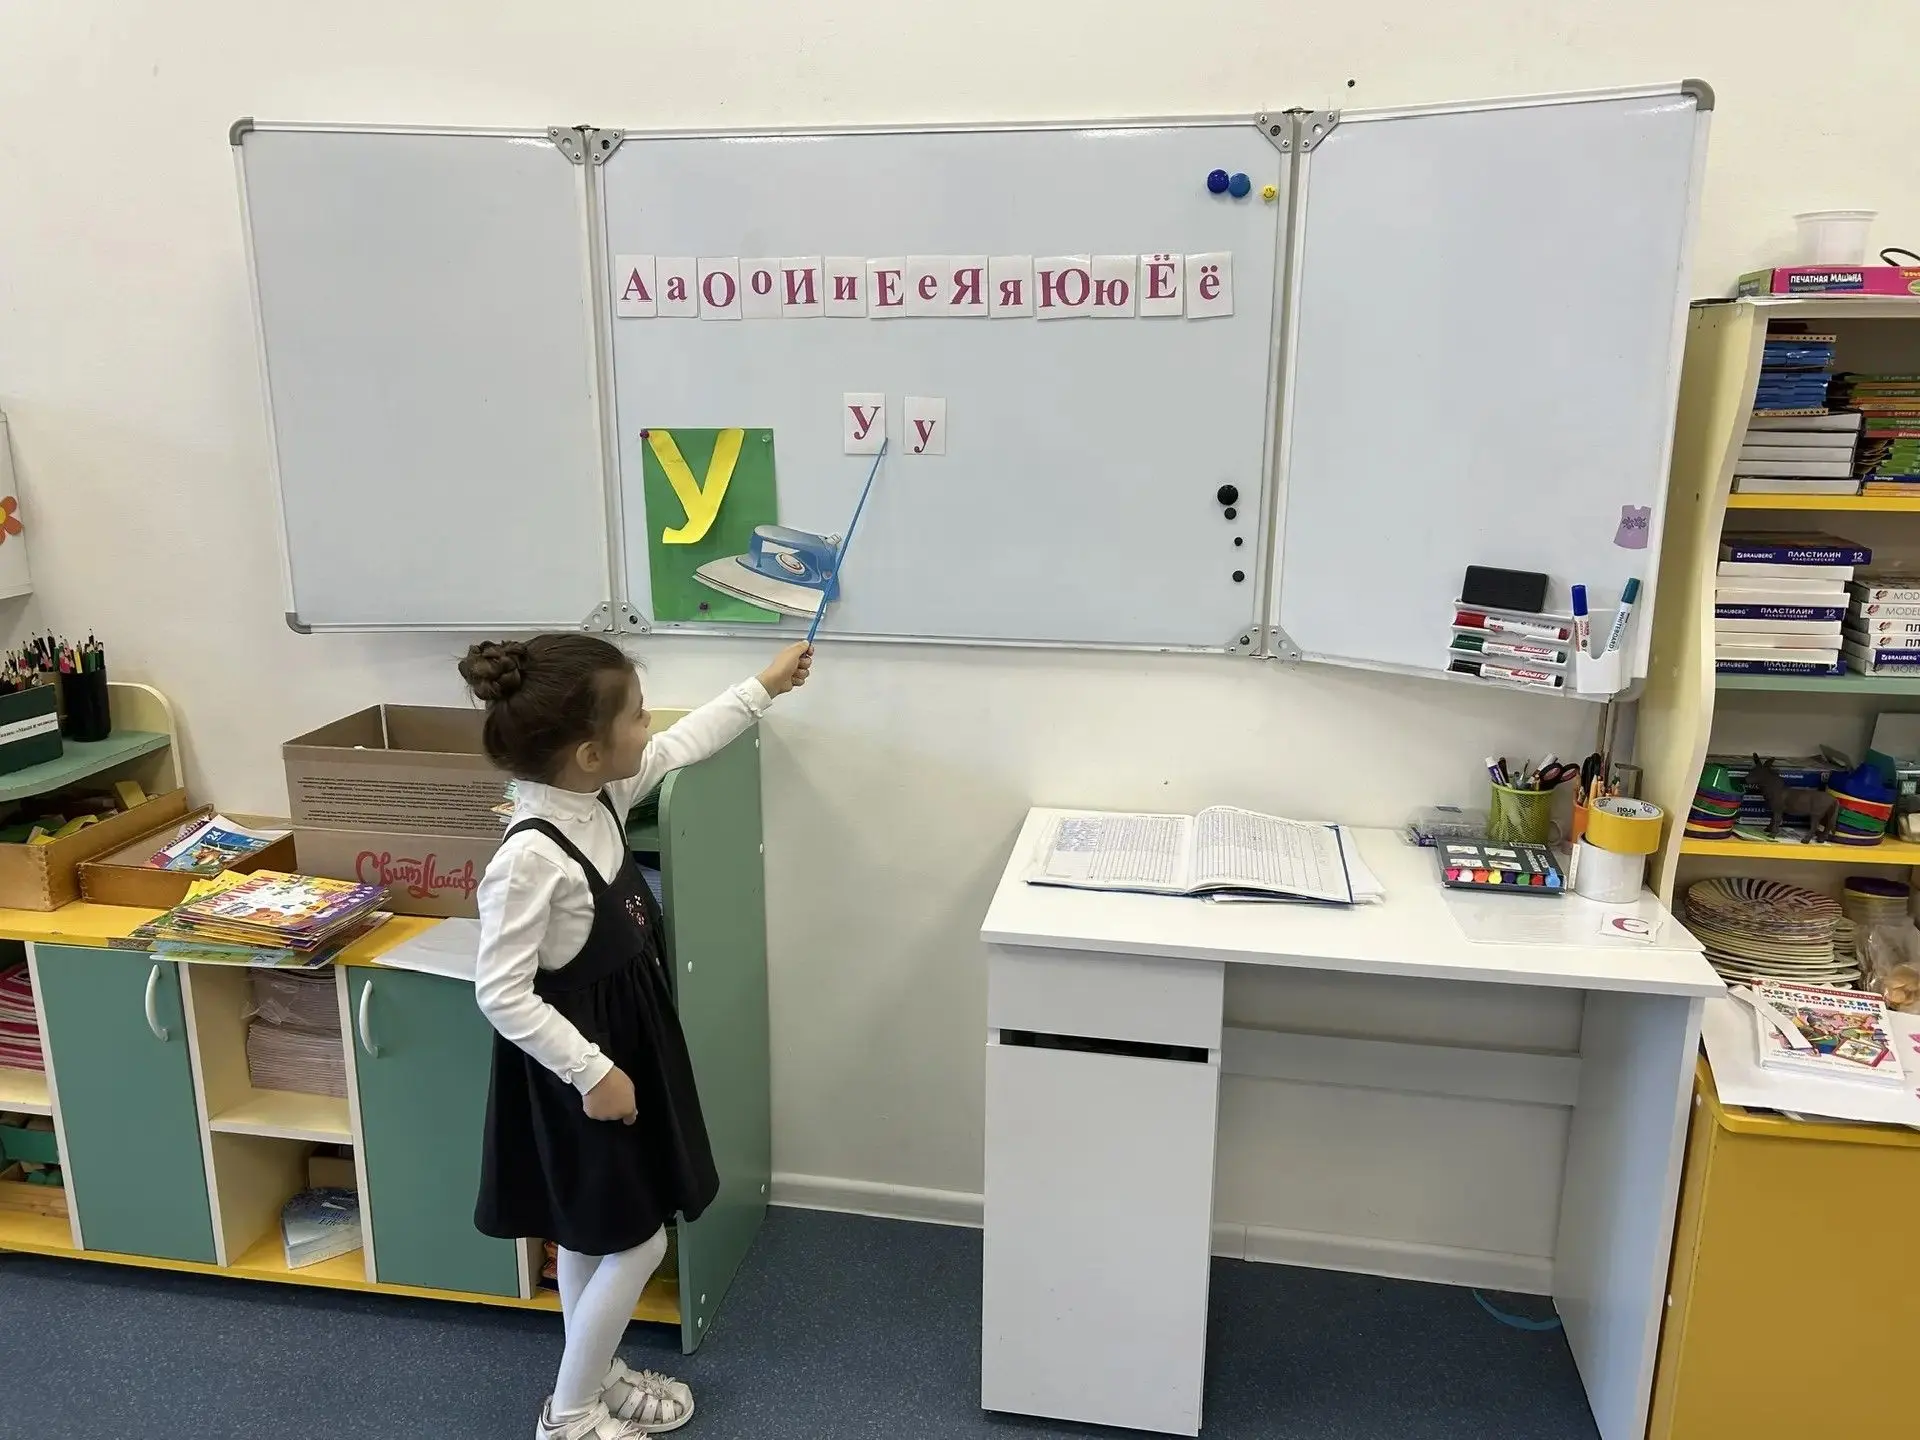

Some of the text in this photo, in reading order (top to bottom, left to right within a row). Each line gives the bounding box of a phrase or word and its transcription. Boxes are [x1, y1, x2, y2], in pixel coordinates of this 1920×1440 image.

[1790, 273, 1862, 283] ПЕЧАТНАЯ МАШИНА
[848, 405, 881, 440] У
[647, 428, 745, 544] У
[1853, 552, 1863, 560] 12
[1760, 607, 1814, 615] ПЛАСТИЛИН
